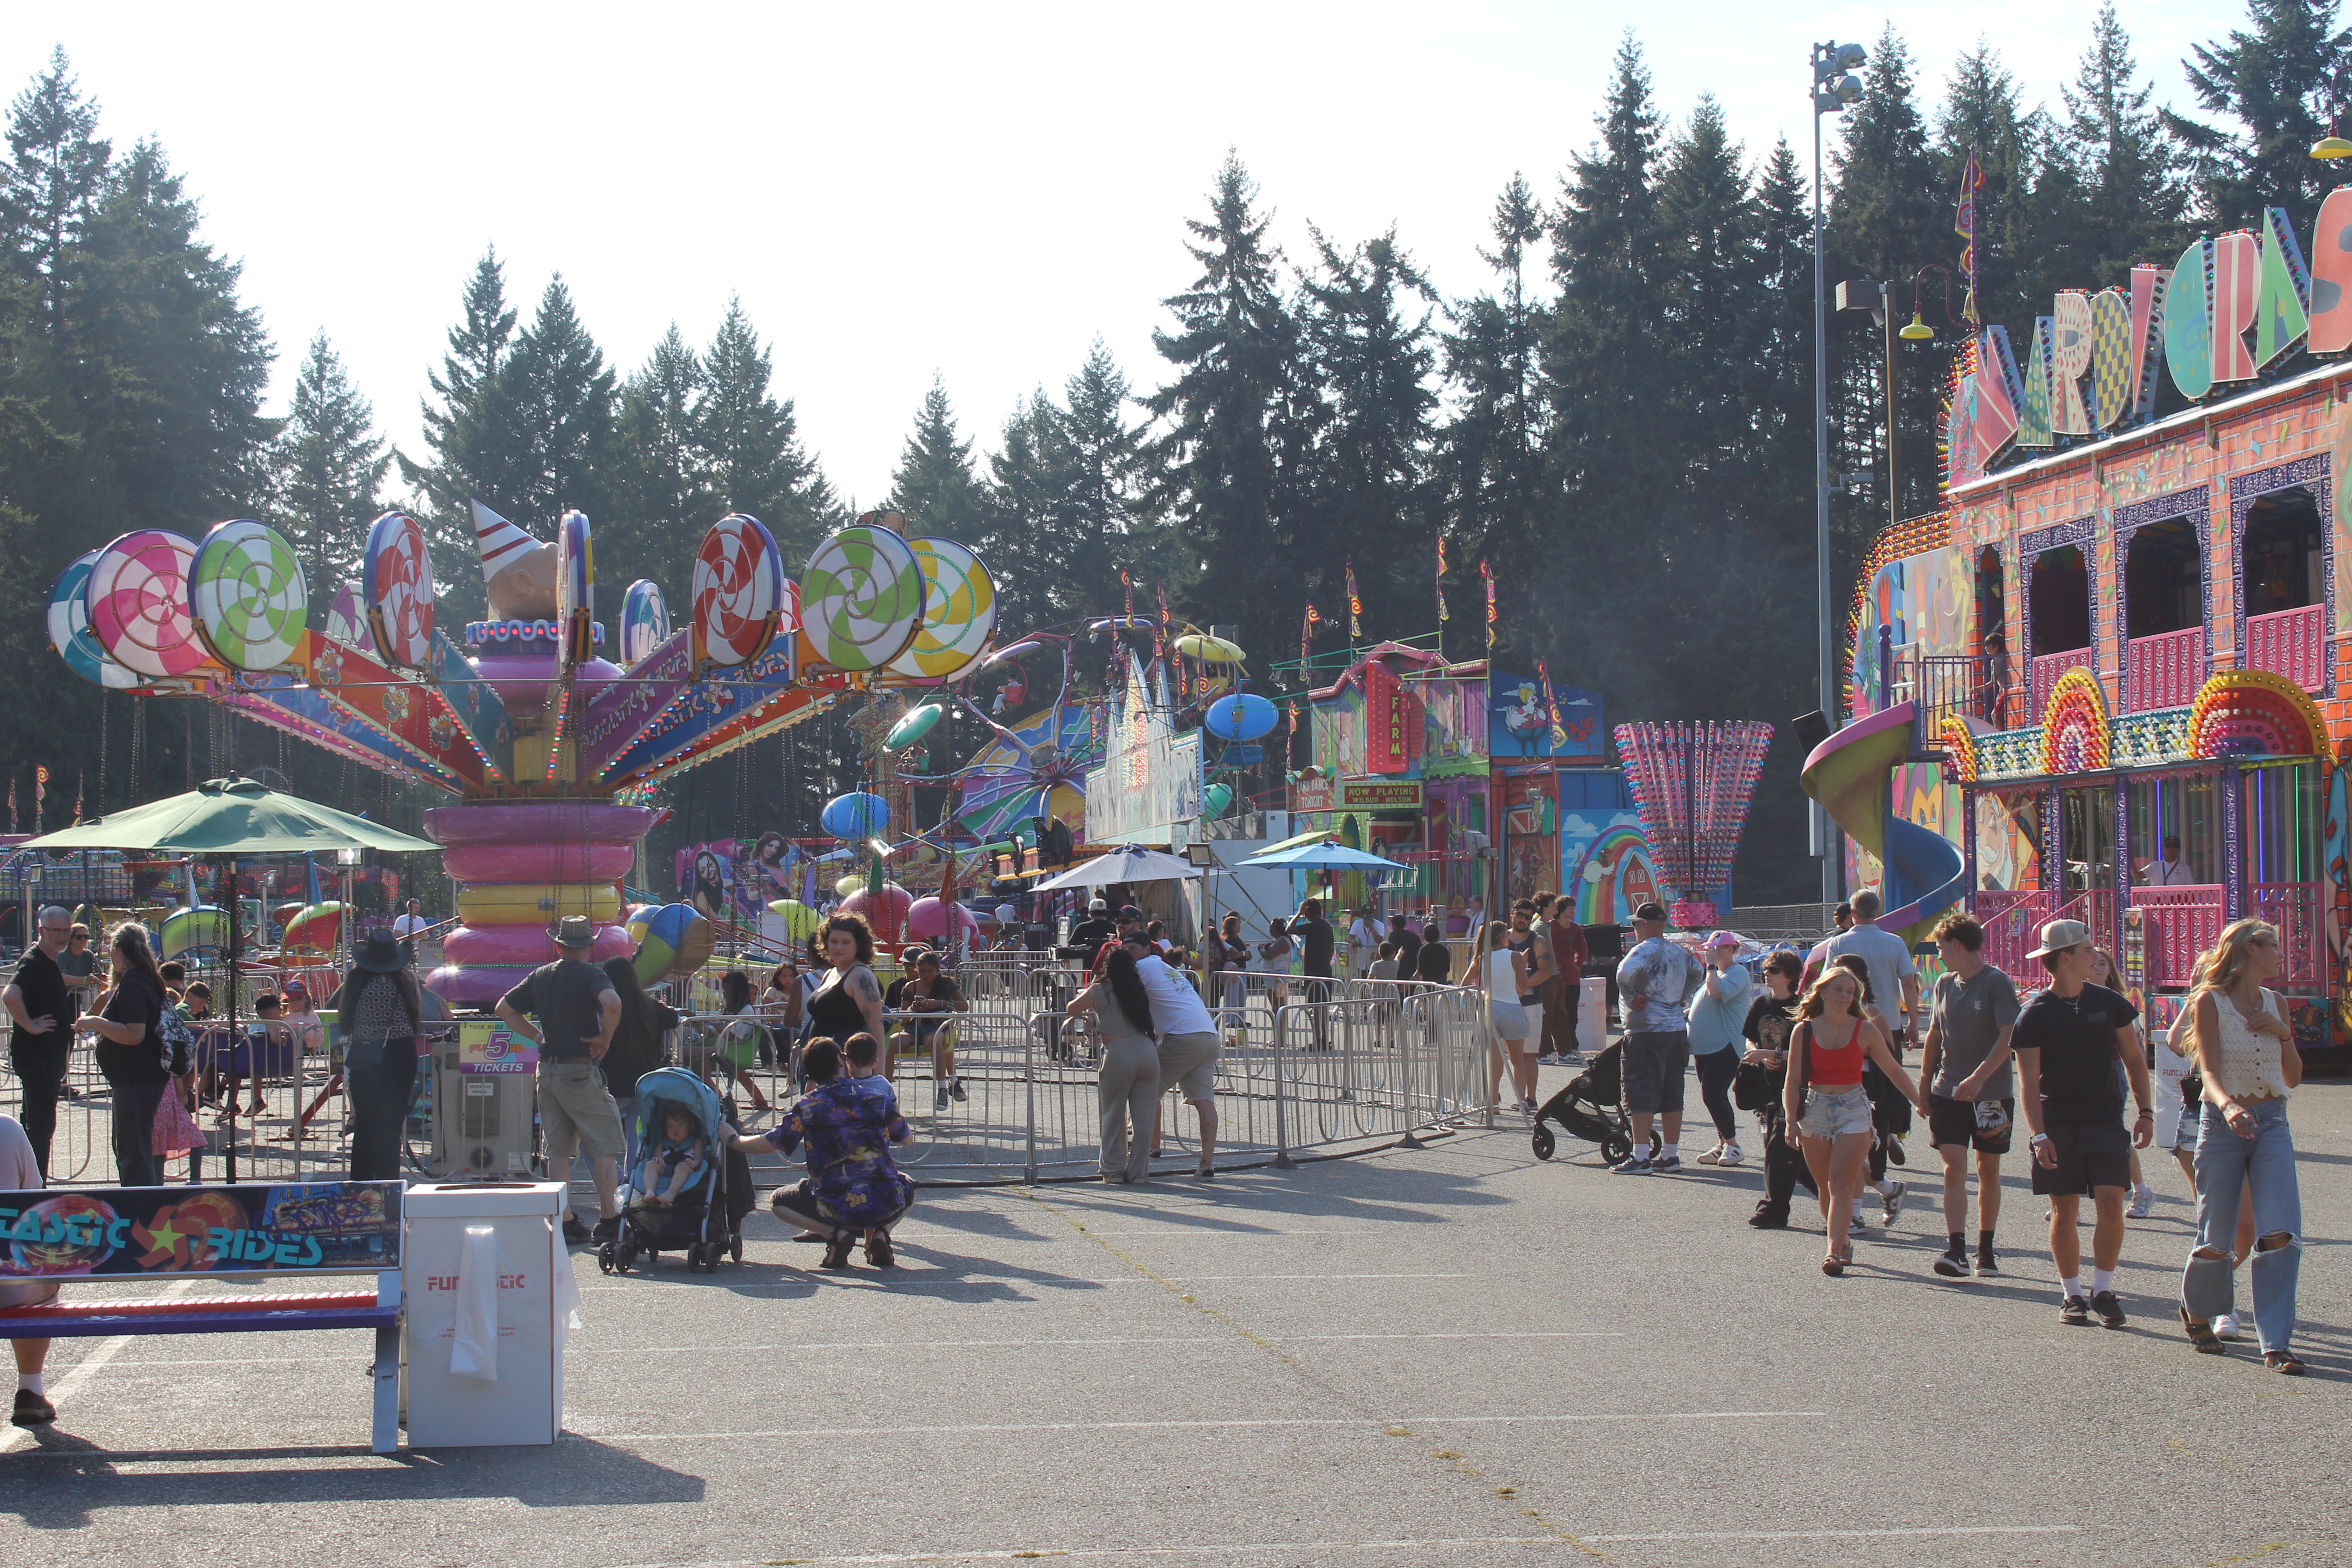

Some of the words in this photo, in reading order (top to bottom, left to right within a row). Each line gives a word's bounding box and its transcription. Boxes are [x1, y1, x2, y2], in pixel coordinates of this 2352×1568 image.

[1975, 265, 2156, 470] MARDI
[2164, 187, 2352, 398] GRAS
[1390, 696, 1401, 755] FARM
[1296, 780, 1310, 793] BARN
[1311, 778, 1328, 791] DANCE
[1301, 794, 1323, 808] TONIGHT
[484, 1031, 513, 1060] 5
[474, 1063, 524, 1072] TICKETS
[207, 1227, 323, 1265] RIDES
[428, 1274, 525, 1291] FUNTIC
